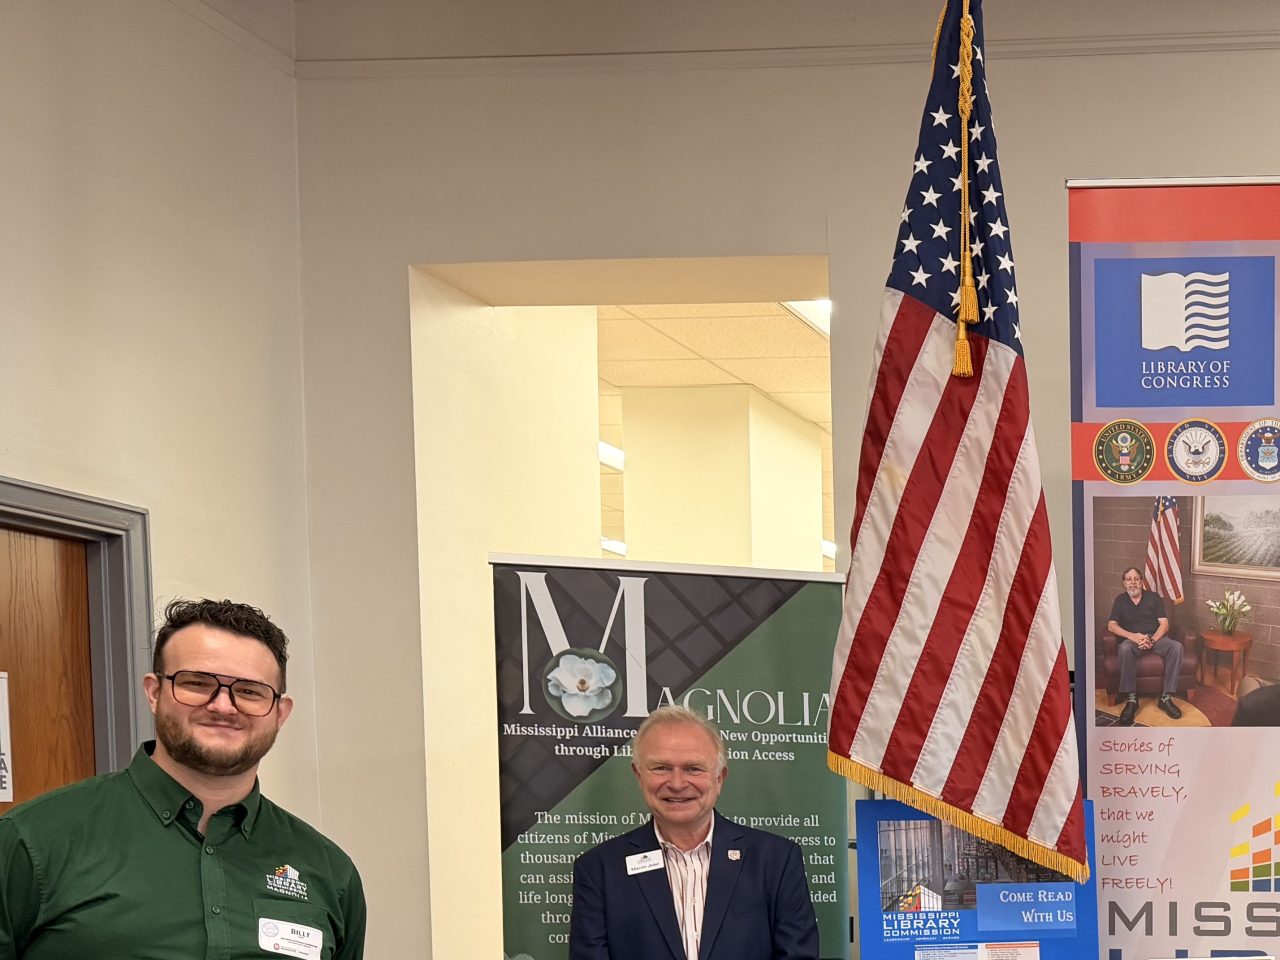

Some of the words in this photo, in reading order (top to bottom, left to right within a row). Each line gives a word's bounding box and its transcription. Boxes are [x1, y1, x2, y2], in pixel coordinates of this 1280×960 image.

[1141, 361, 1208, 374] LIBRARY
[1209, 361, 1230, 374] OF
[1142, 376, 1229, 388] CONGRESS
[504, 724, 578, 739] Mississippi
[582, 725, 638, 738] Alliance
[720, 731, 748, 743] New
[752, 731, 828, 747] Opportuniti
[555, 744, 609, 758] through
[1099, 738, 1153, 752] Stories
[1159, 738, 1174, 756] of
[752, 750, 794, 760] Access
[1100, 763, 1180, 777] SERVING
[1100, 786, 1187, 802] BRAVELY,
[534, 812, 560, 824] The
[565, 812, 617, 824] mission
[622, 812, 636, 824] of
[734, 816, 746, 825] to
[750, 814, 800, 828] provide
[804, 815, 819, 826] all
[1100, 808, 1131, 821] that
[1136, 811, 1154, 821] we
[518, 831, 570, 844] citizens
[574, 832, 589, 844] of
[1101, 830, 1146, 848] might
[1102, 855, 1137, 866] LIVE
[520, 874, 544, 884] can
[1101, 878, 1172, 892] FREELY!
[519, 891, 541, 904] life
[545, 891, 573, 906] long
[1000, 891, 1034, 902] COME
[1038, 890, 1072, 902] READ
[883, 912, 959, 920] MISSISSIPPI
[1022, 908, 1053, 922] WITH
[883, 919, 960, 930] LIBRARY
[291, 928, 310, 938] BILLY
[884, 929, 959, 937] COMMISSION
